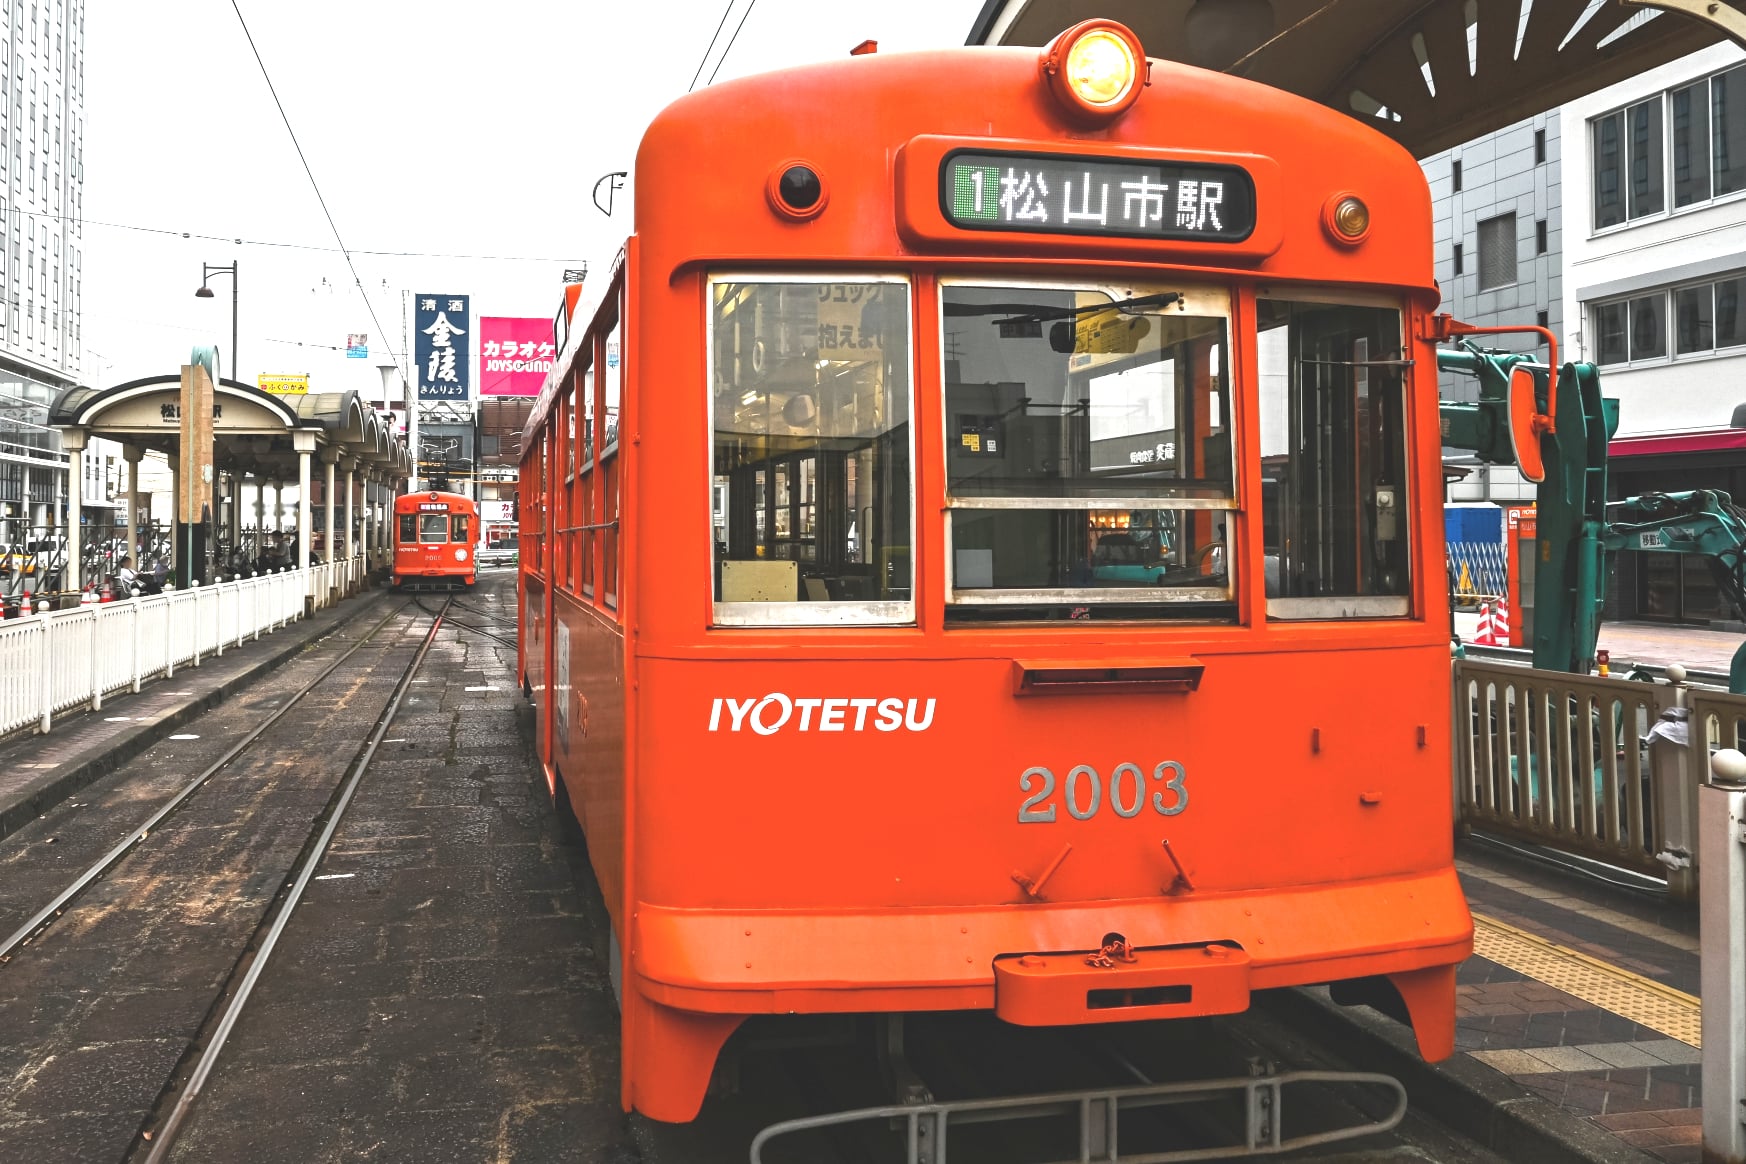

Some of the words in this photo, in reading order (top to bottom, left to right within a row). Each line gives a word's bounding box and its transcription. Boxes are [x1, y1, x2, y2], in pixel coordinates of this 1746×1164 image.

[971, 171, 983, 212] 1
[1000, 167, 1223, 231] 松山市駅
[483, 340, 555, 357] カラオケ
[420, 385, 463, 395] きんりょう
[708, 692, 936, 736] IYOTETSU
[1018, 760, 1189, 824] 2003
